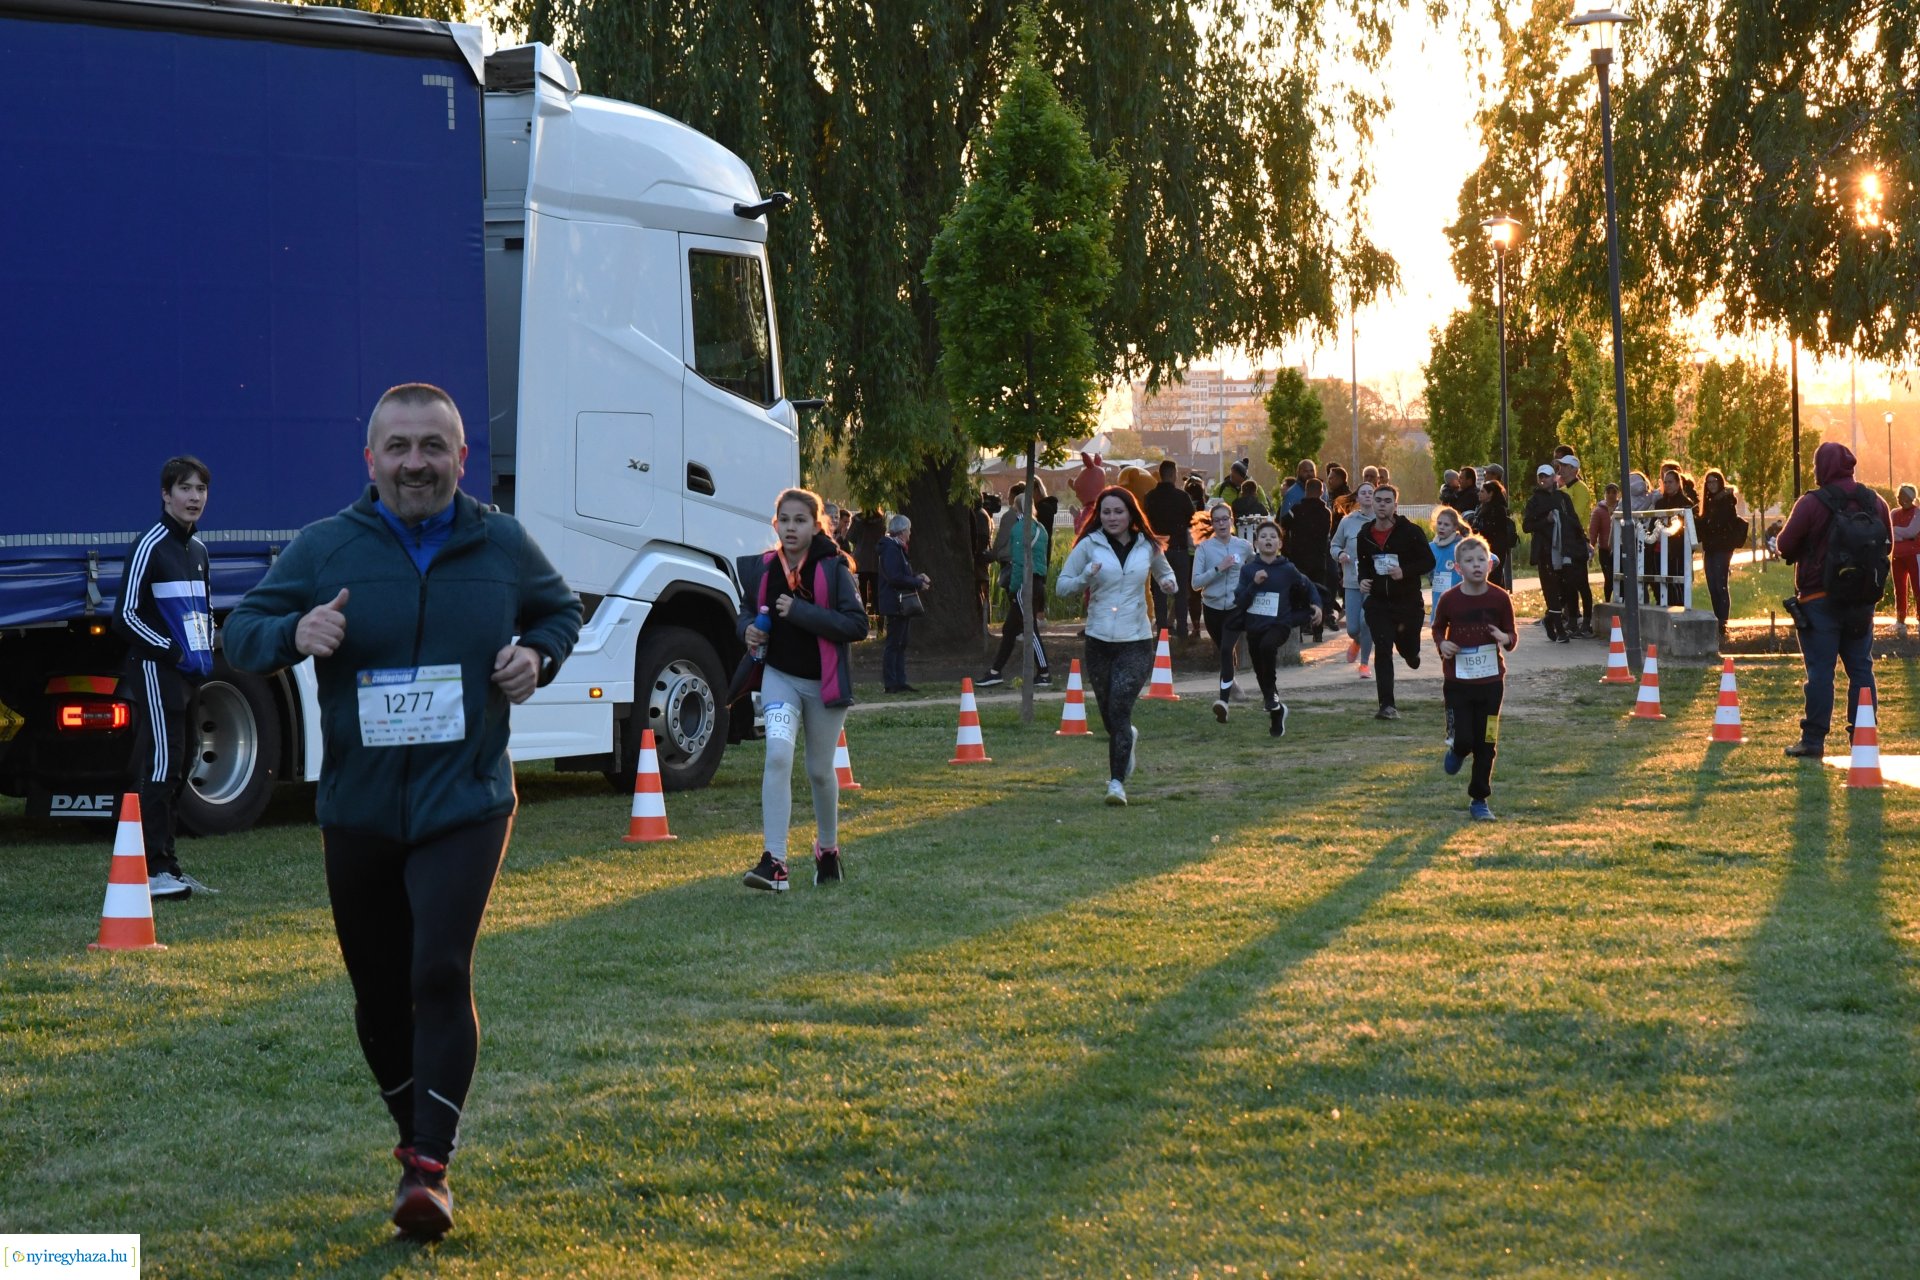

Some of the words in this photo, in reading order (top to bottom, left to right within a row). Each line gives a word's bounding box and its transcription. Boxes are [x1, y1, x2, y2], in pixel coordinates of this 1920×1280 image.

[627, 458, 650, 473] XG
[1464, 655, 1487, 667] 1587
[383, 690, 434, 714] 1277
[765, 712, 791, 725] 1760
[51, 794, 114, 810] DAF
